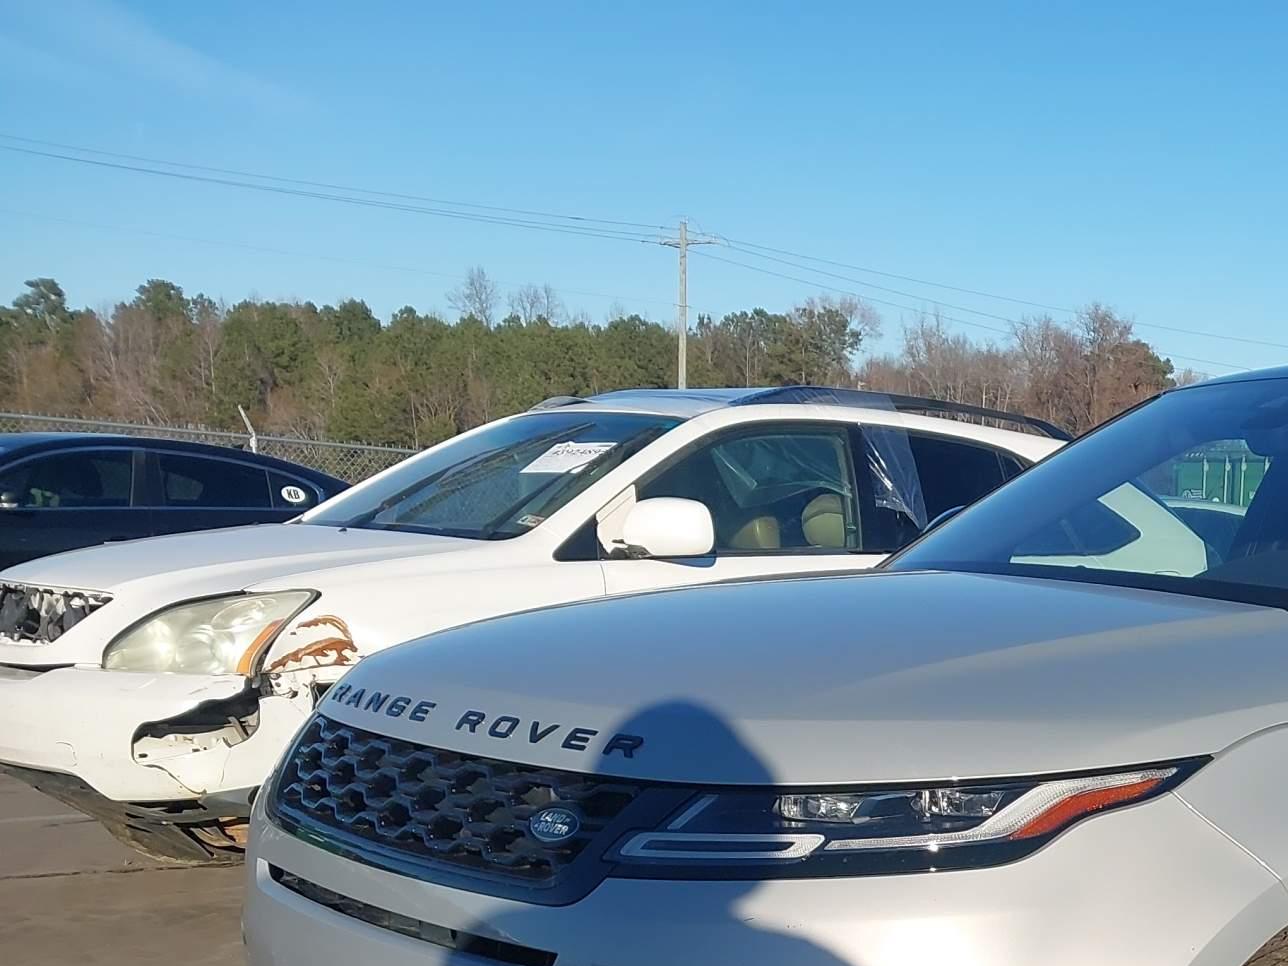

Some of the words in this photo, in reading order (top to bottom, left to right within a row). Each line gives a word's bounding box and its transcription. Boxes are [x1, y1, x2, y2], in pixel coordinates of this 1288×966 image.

[332, 682, 436, 722] RANGE
[455, 709, 645, 759] ROVER
[540, 811, 566, 823] LAND
[537, 822, 569, 836] ROVER
